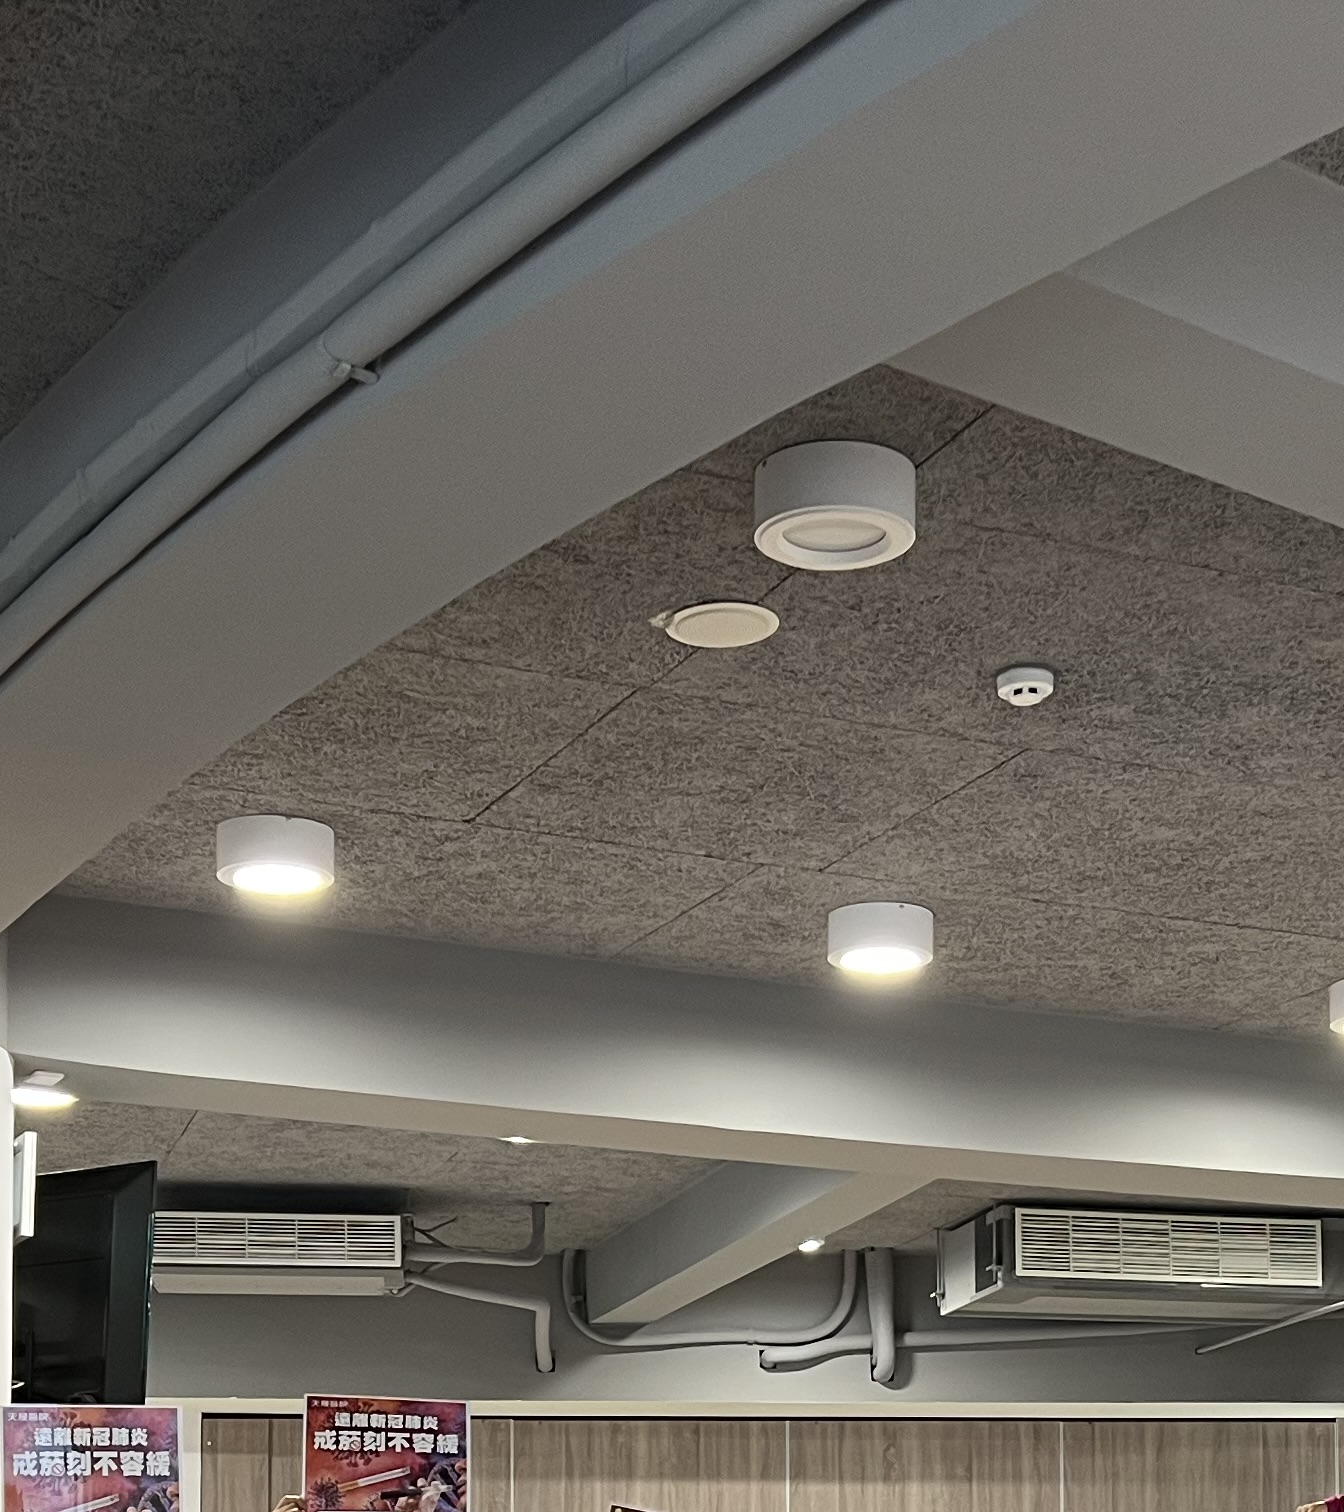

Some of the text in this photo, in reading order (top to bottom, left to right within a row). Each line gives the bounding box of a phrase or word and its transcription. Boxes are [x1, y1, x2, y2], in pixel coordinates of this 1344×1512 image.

[335, 1412, 438, 1430] 遠離新冠肺炎
[34, 1427, 148, 1447] 遠離新冠肺炎
[314, 1429, 459, 1454] 戒菸刻不容緩
[12, 1451, 171, 1477] 戒菸刻不容緩
